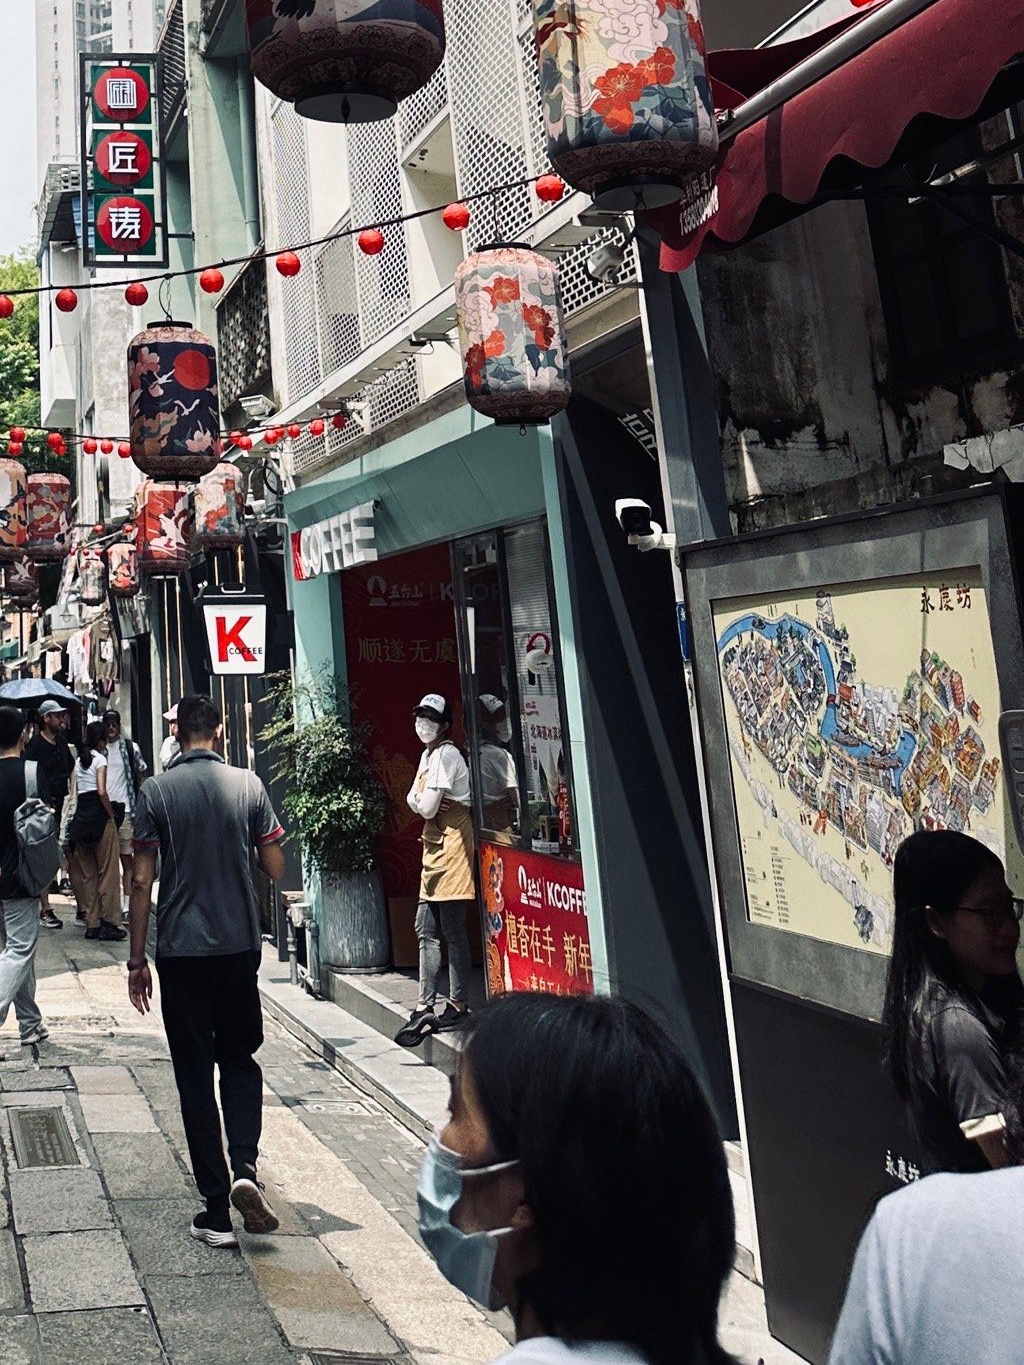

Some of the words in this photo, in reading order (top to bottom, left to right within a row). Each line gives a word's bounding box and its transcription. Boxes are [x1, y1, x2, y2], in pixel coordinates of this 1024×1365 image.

[215, 616, 258, 662] K
[228, 647, 263, 655] COFFEE
[358, 637, 458, 664] 顺遂无虞
[546, 881, 588, 916] KCOFFE
